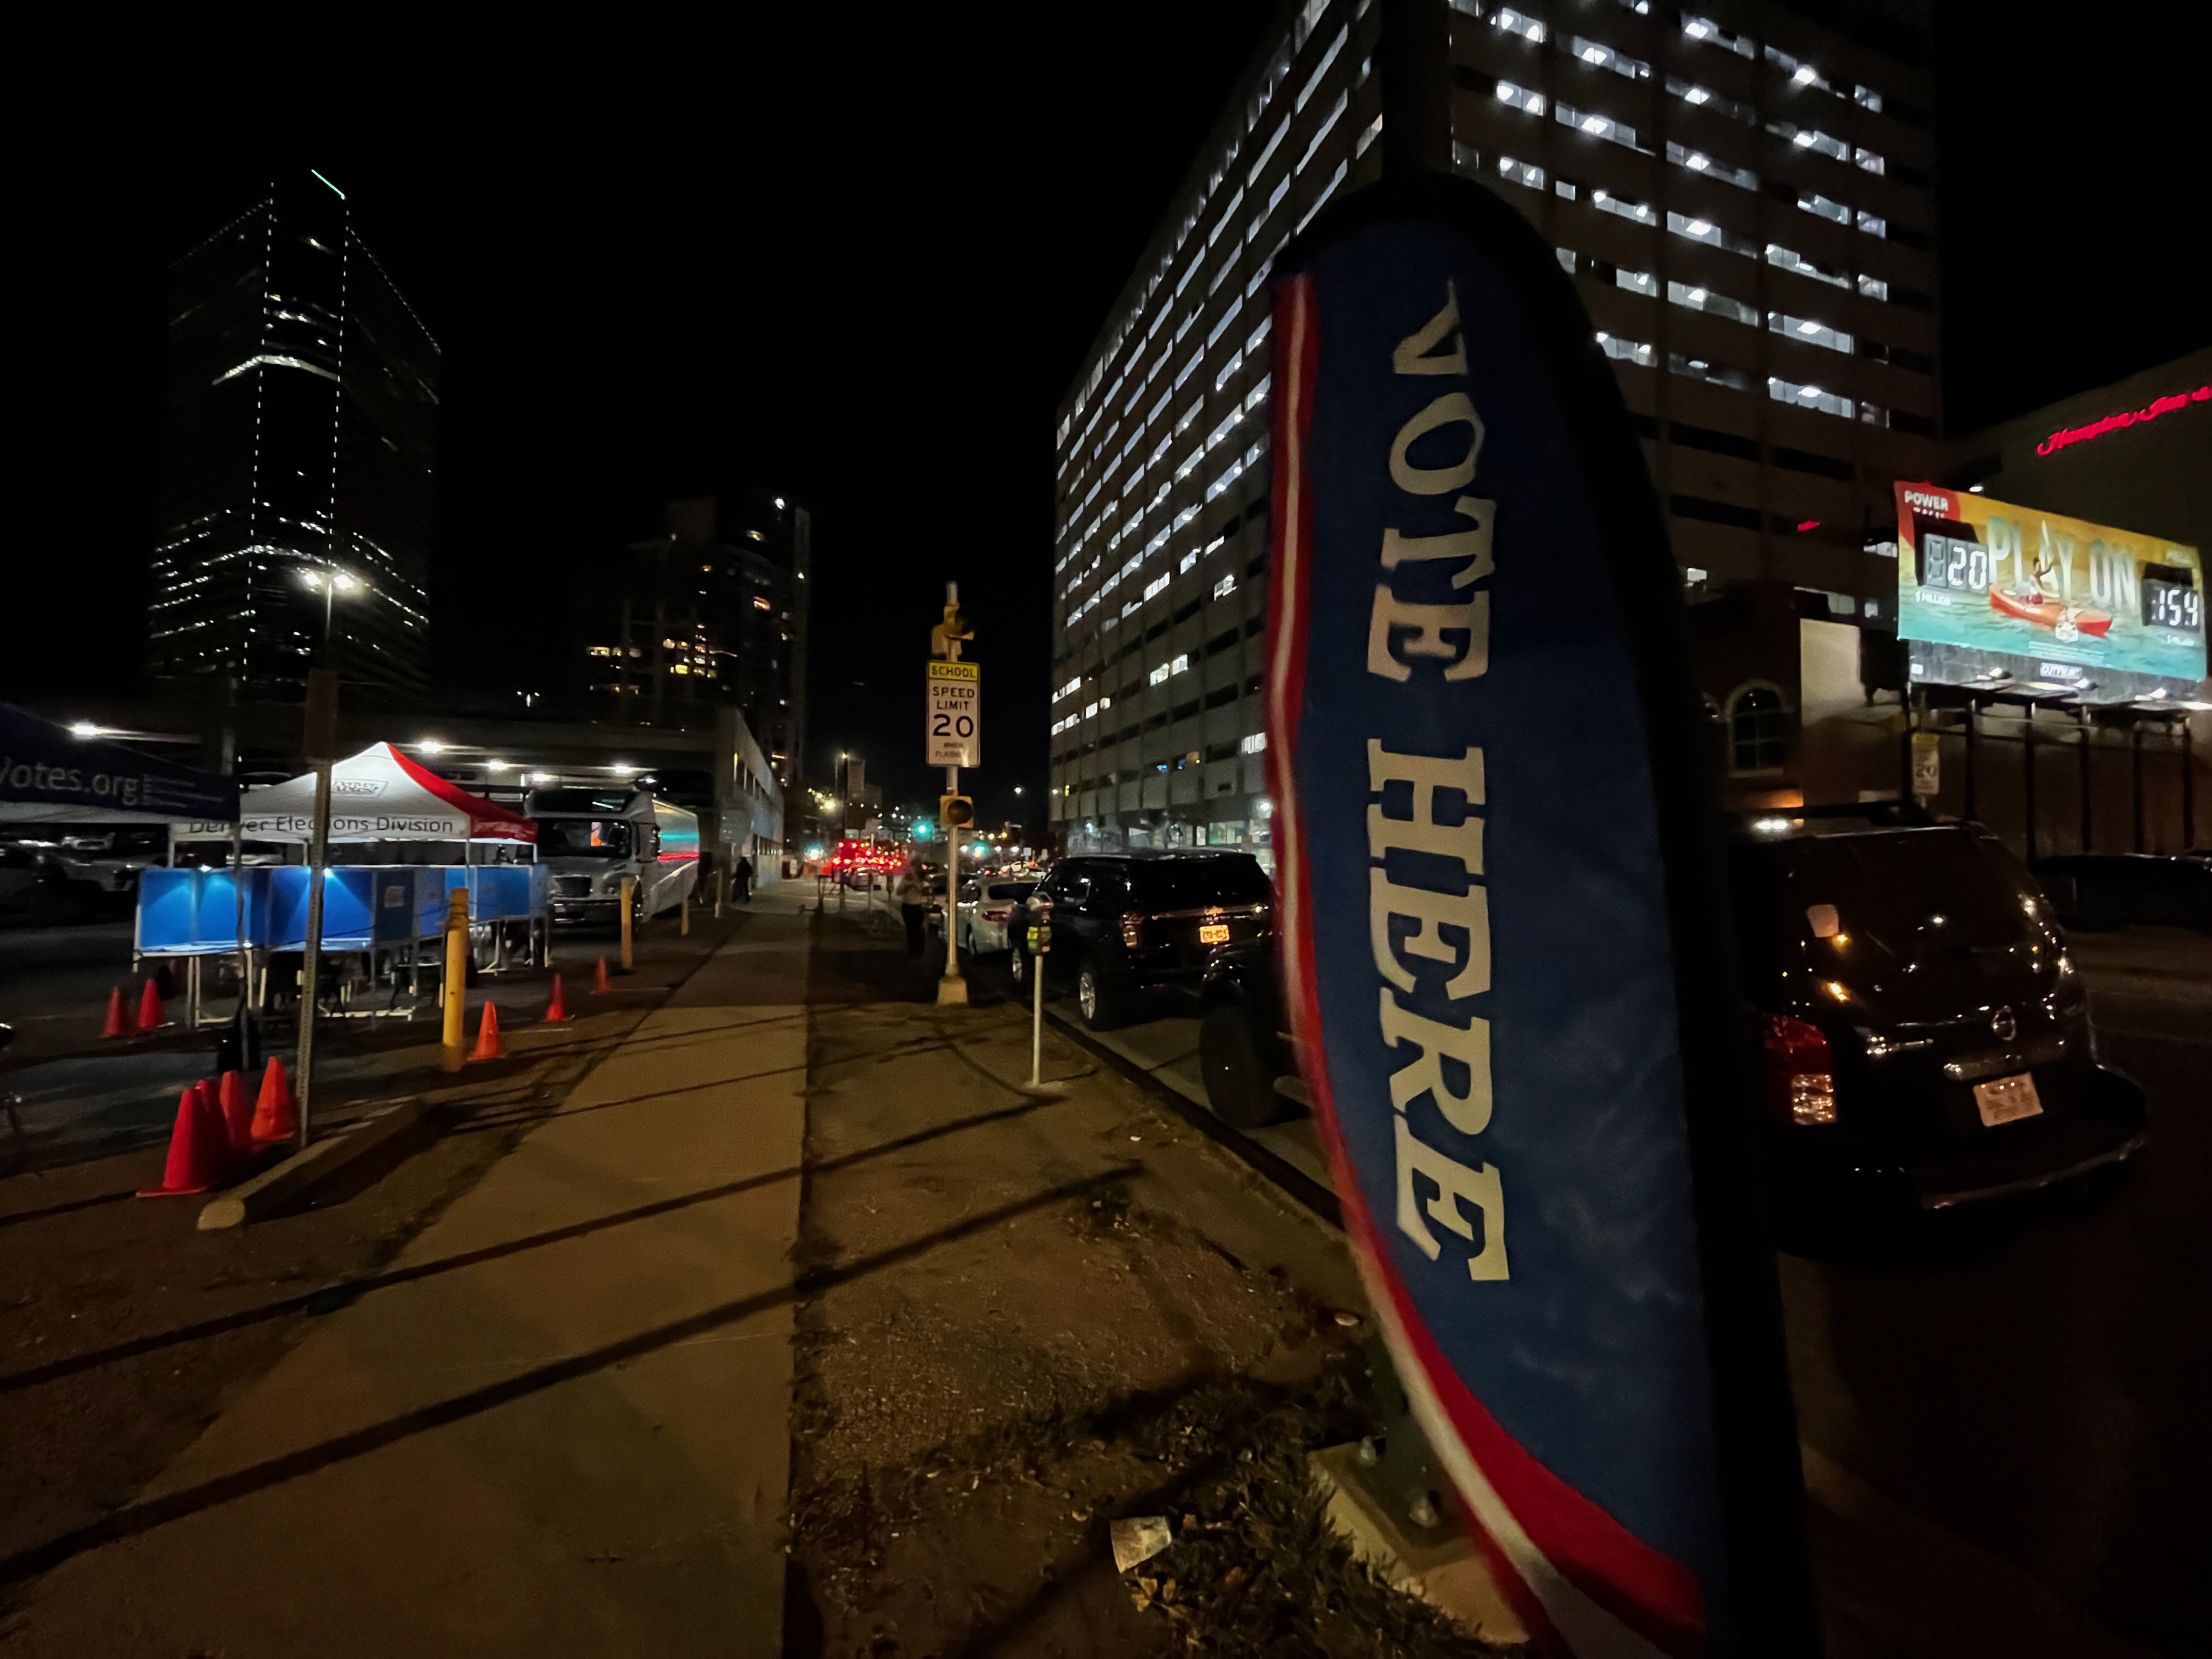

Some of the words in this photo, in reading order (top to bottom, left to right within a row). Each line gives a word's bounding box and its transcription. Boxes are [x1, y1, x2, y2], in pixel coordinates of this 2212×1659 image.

[1368, 278, 1497, 681] VOTE
[1904, 490, 1949, 511] POWER
[1948, 546, 1987, 590] 20
[2089, 539, 2140, 612] ON
[932, 665, 976, 678] SCHOOL
[933, 686, 975, 698] SPEED
[936, 699, 969, 710] LIMIT
[933, 714, 973, 737] 20
[277, 816, 368, 831] Elecons
[377, 817, 453, 832] Division
[1367, 738, 1510, 1280] HERE
